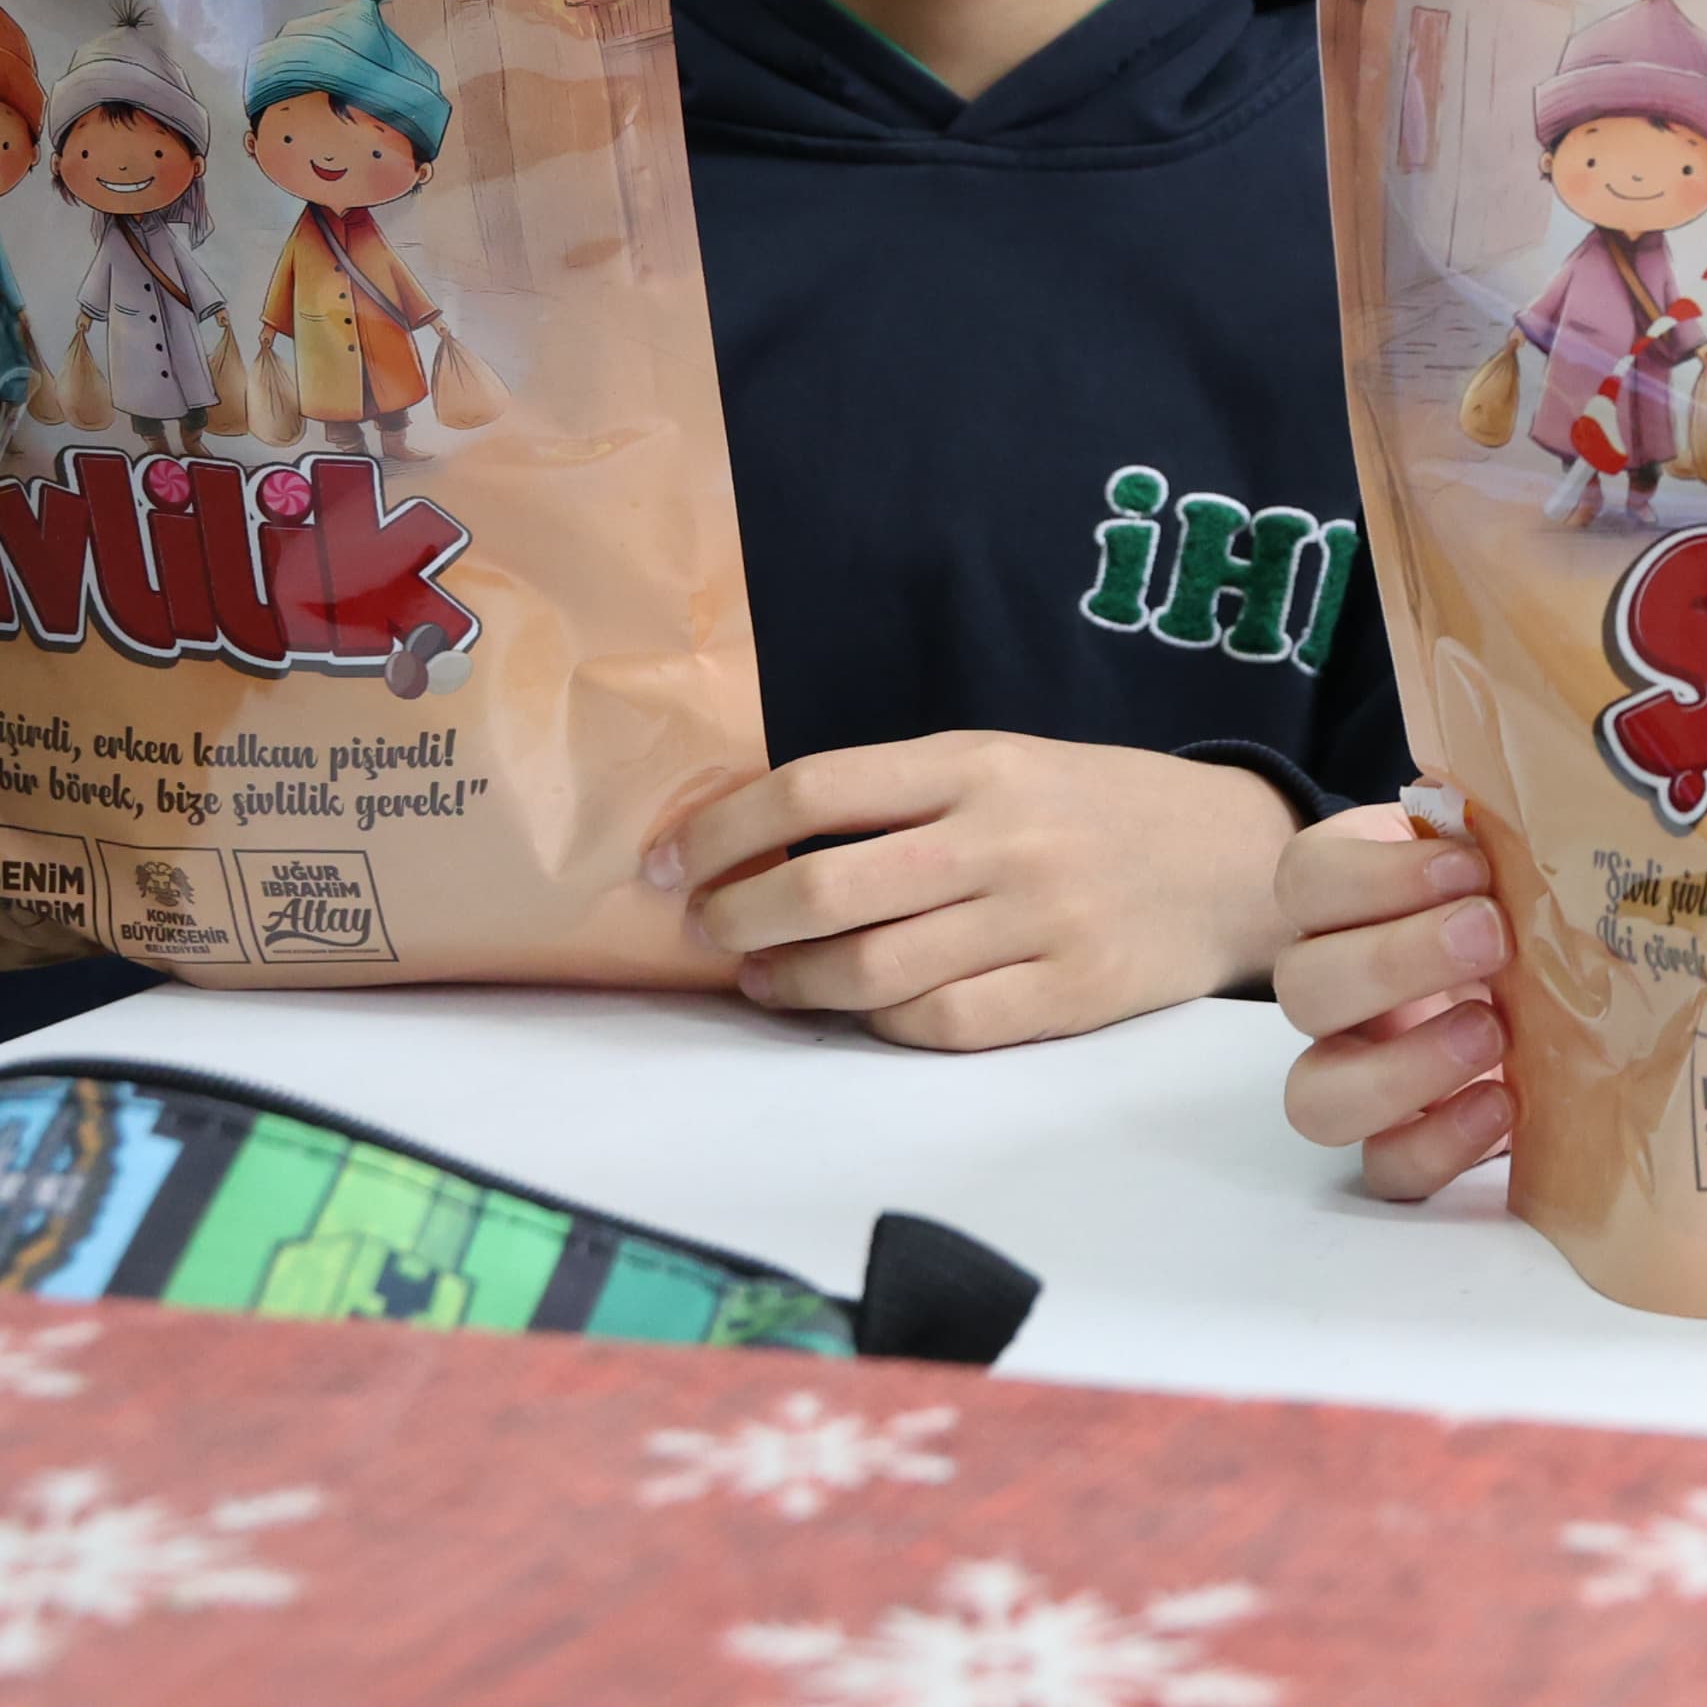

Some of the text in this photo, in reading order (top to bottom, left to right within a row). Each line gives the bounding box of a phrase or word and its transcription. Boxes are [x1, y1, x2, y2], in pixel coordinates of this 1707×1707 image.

[0, 446, 482, 674] vlilik
[94, 726, 183, 766] erken
[193, 731, 318, 770] kalkan
[329, 728, 457, 782] pişirdi!
[49, 765, 145, 821] börek,
[157, 779, 222, 826] bize
[232, 781, 344, 827] şivlilik
[0, 860, 85, 895] ENİM
[272, 860, 341, 882] UĞUR
[146, 908, 198, 928] KONYA
[262, 898, 373, 948] Altay
